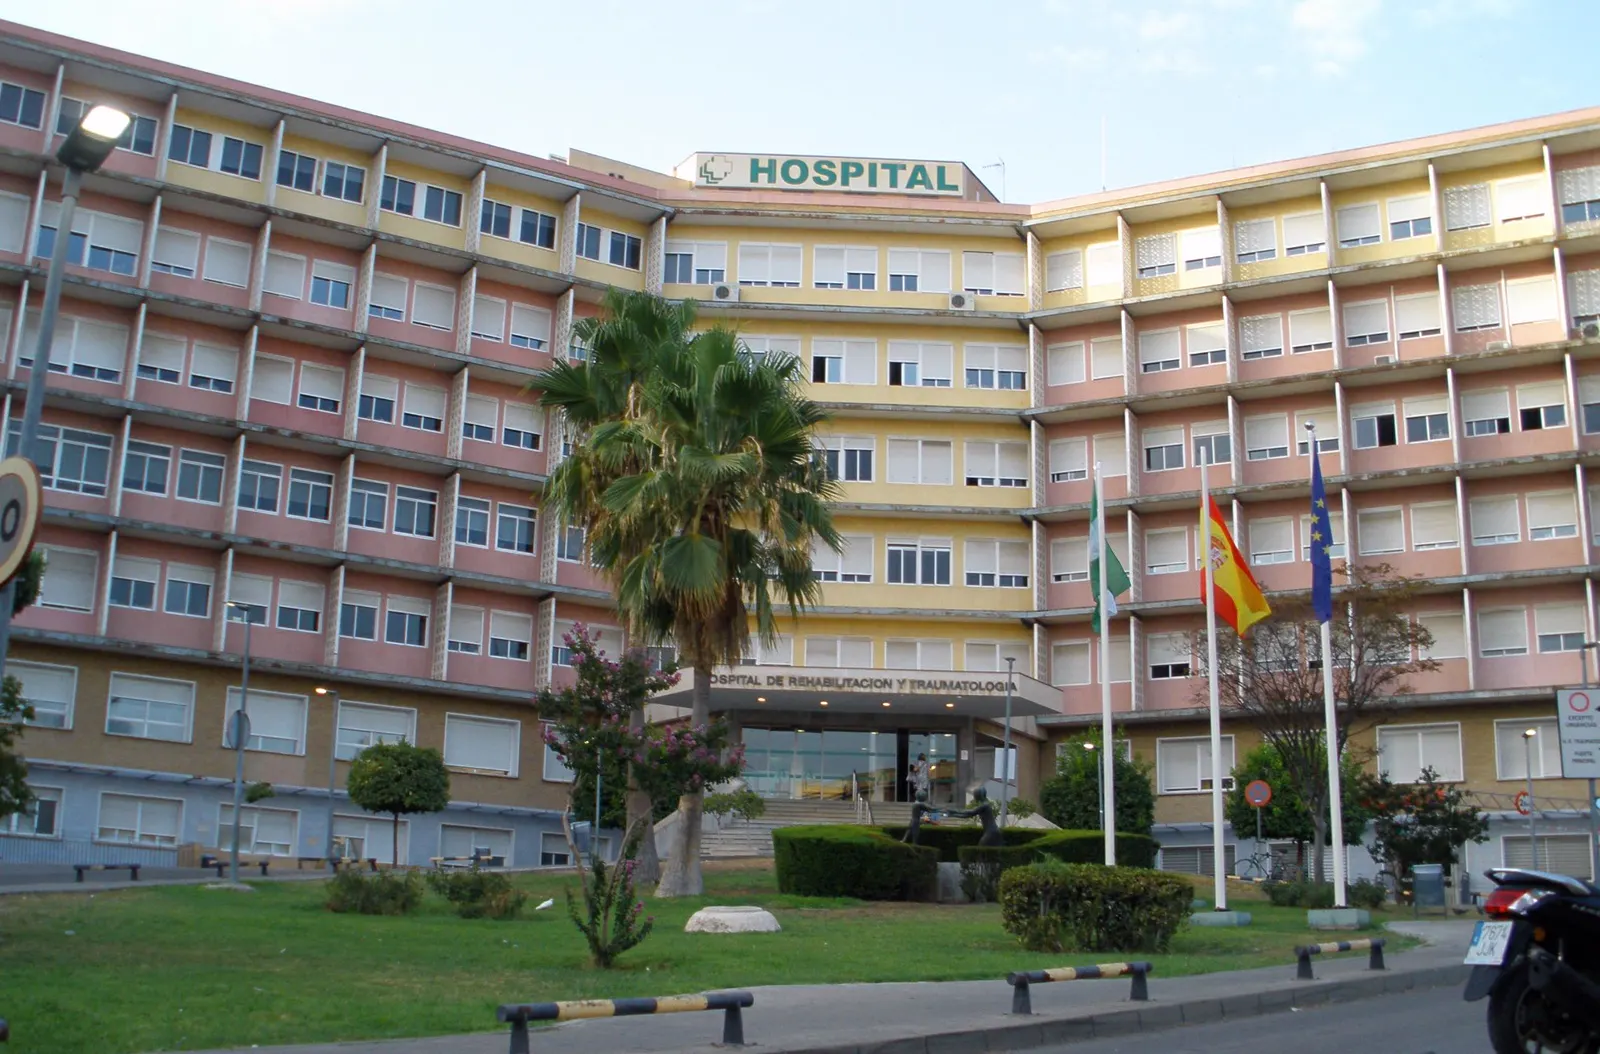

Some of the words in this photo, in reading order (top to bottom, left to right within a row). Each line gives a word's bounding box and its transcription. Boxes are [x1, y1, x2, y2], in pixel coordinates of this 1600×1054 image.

[750, 158, 959, 192] HOSPITAL
[1, 499, 20, 542] 0
[710, 674, 761, 686] OSPITAL
[766, 675, 784, 687] DE
[789, 676, 892, 689] REHABILITACION
[896, 679, 907, 690] Y
[909, 679, 1018, 692] TRAUMATOLOGIA
